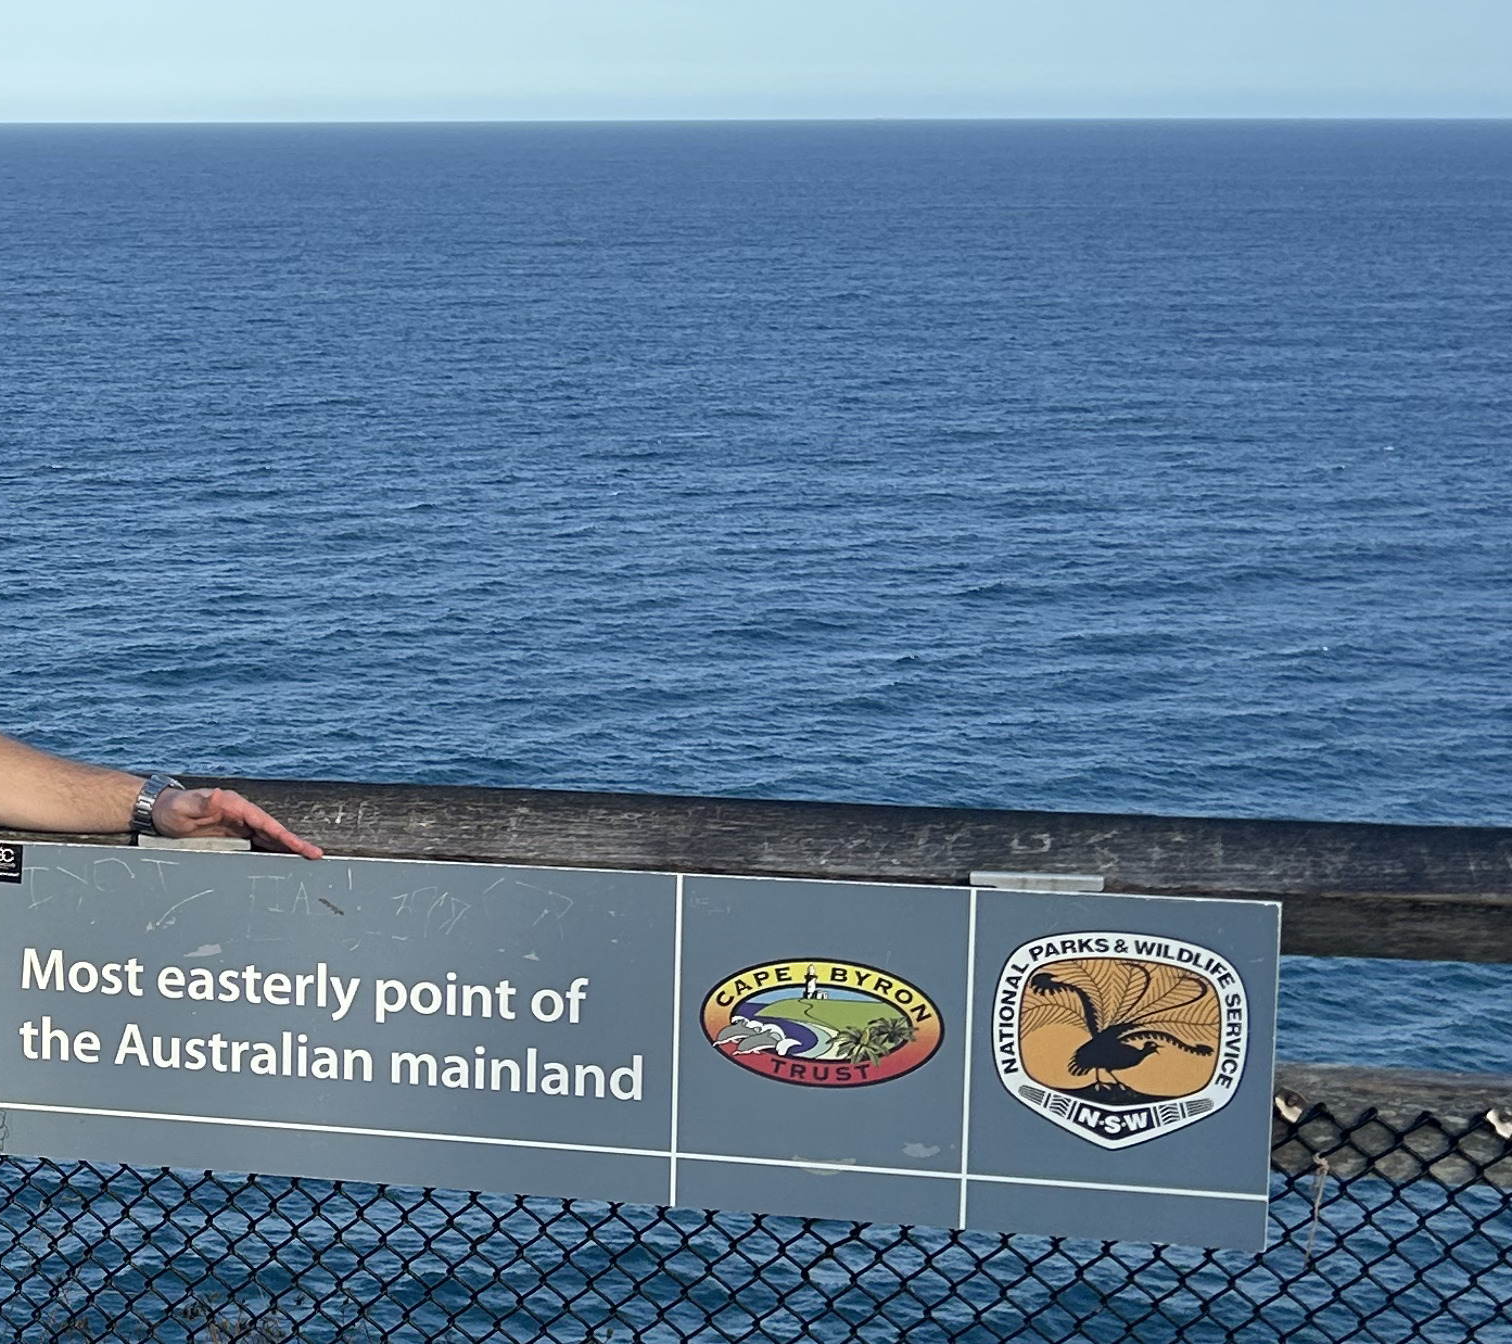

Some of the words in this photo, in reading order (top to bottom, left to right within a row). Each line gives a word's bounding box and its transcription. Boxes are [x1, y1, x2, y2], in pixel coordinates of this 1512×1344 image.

[20, 947, 145, 997] Most
[156, 962, 361, 1022] easterly
[375, 972, 518, 1024] point
[530, 977, 590, 1024] of
[715, 966, 793, 1008] CAPE
[829, 967, 933, 1023] BYRON
[998, 962, 1030, 1075] NATIONAL
[1028, 938, 1110, 962] PARKS
[1115, 938, 1129, 953] &
[1134, 939, 1237, 990] WILDLIFE
[1215, 992, 1243, 1090] SERVICE
[18, 1015, 101, 1063] the
[114, 1022, 374, 1083] Australian
[390, 1046, 644, 1102] mainland
[770, 1058, 871, 1082] TRUST
